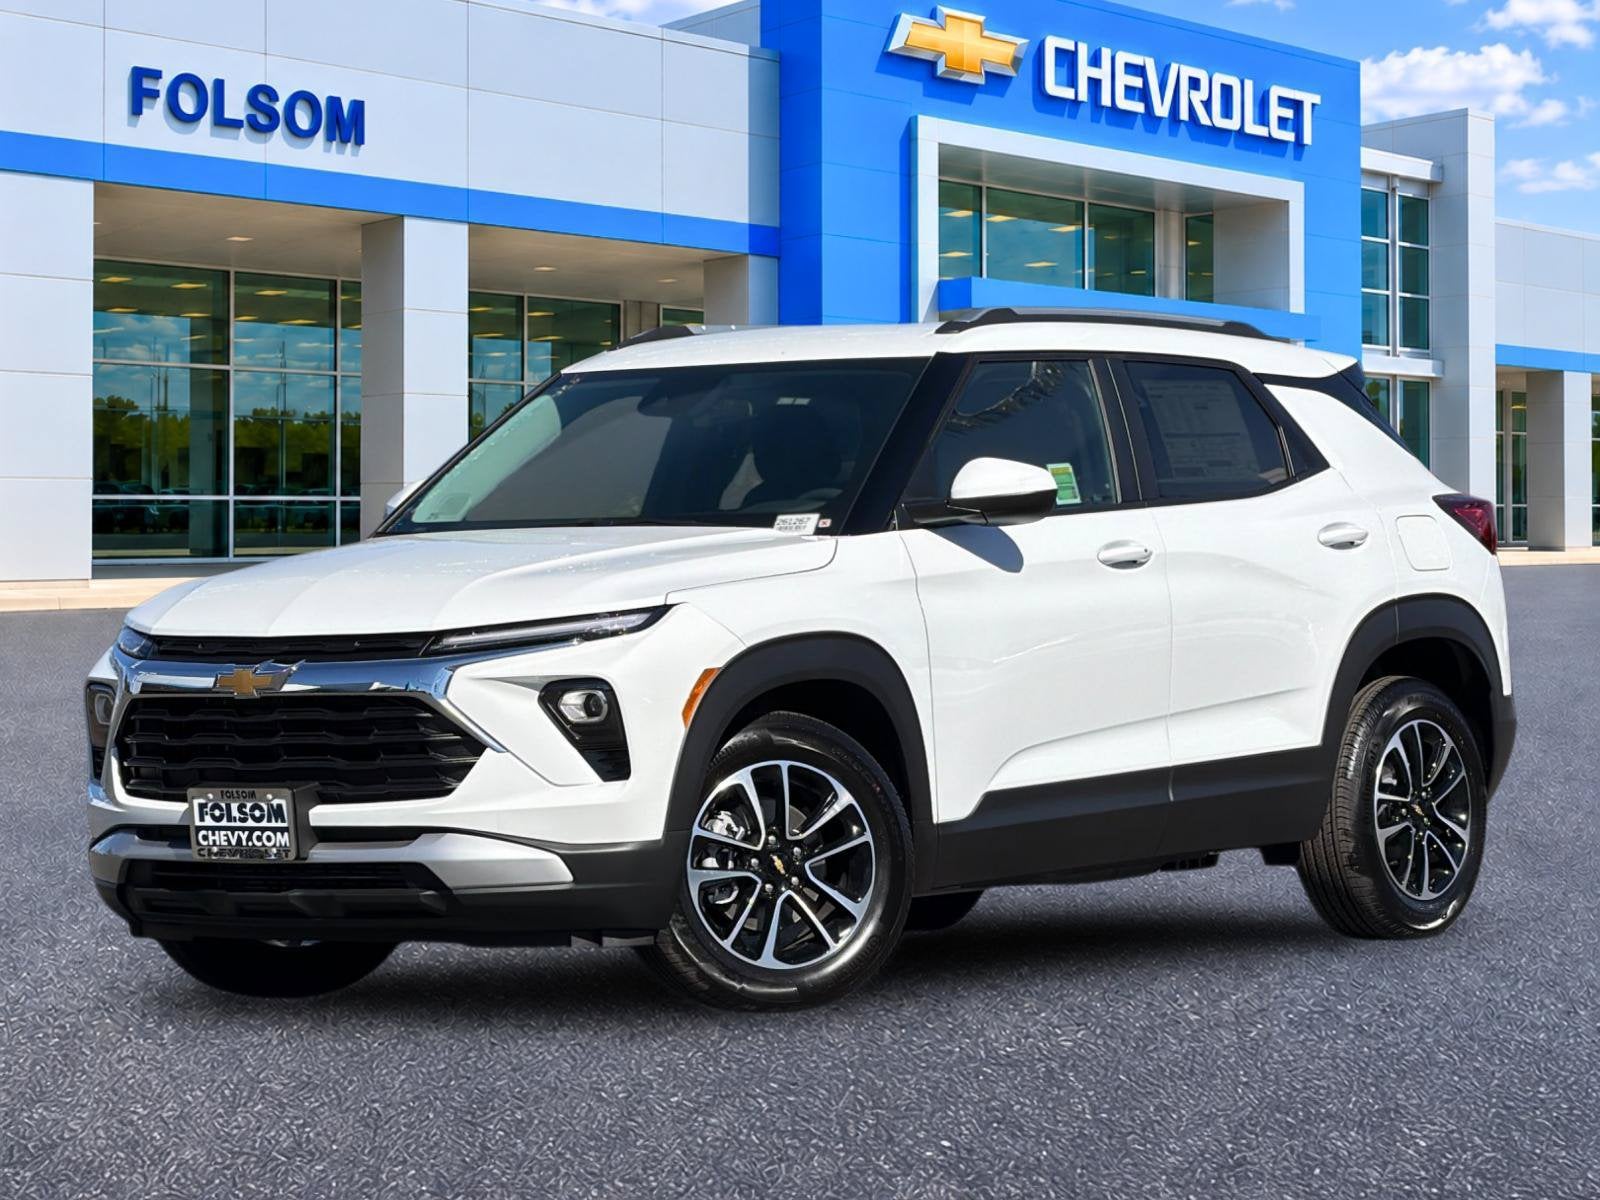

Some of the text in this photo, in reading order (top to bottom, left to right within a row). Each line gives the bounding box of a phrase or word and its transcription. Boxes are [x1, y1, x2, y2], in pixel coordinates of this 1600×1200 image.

[1044, 35, 1321, 145] CHEVROLET
[130, 65, 365, 146] FOLSOM
[220, 790, 256, 799] FOLSOM
[198, 802, 287, 823] FOLSOM
[198, 830, 290, 847] CHEVY.COM
